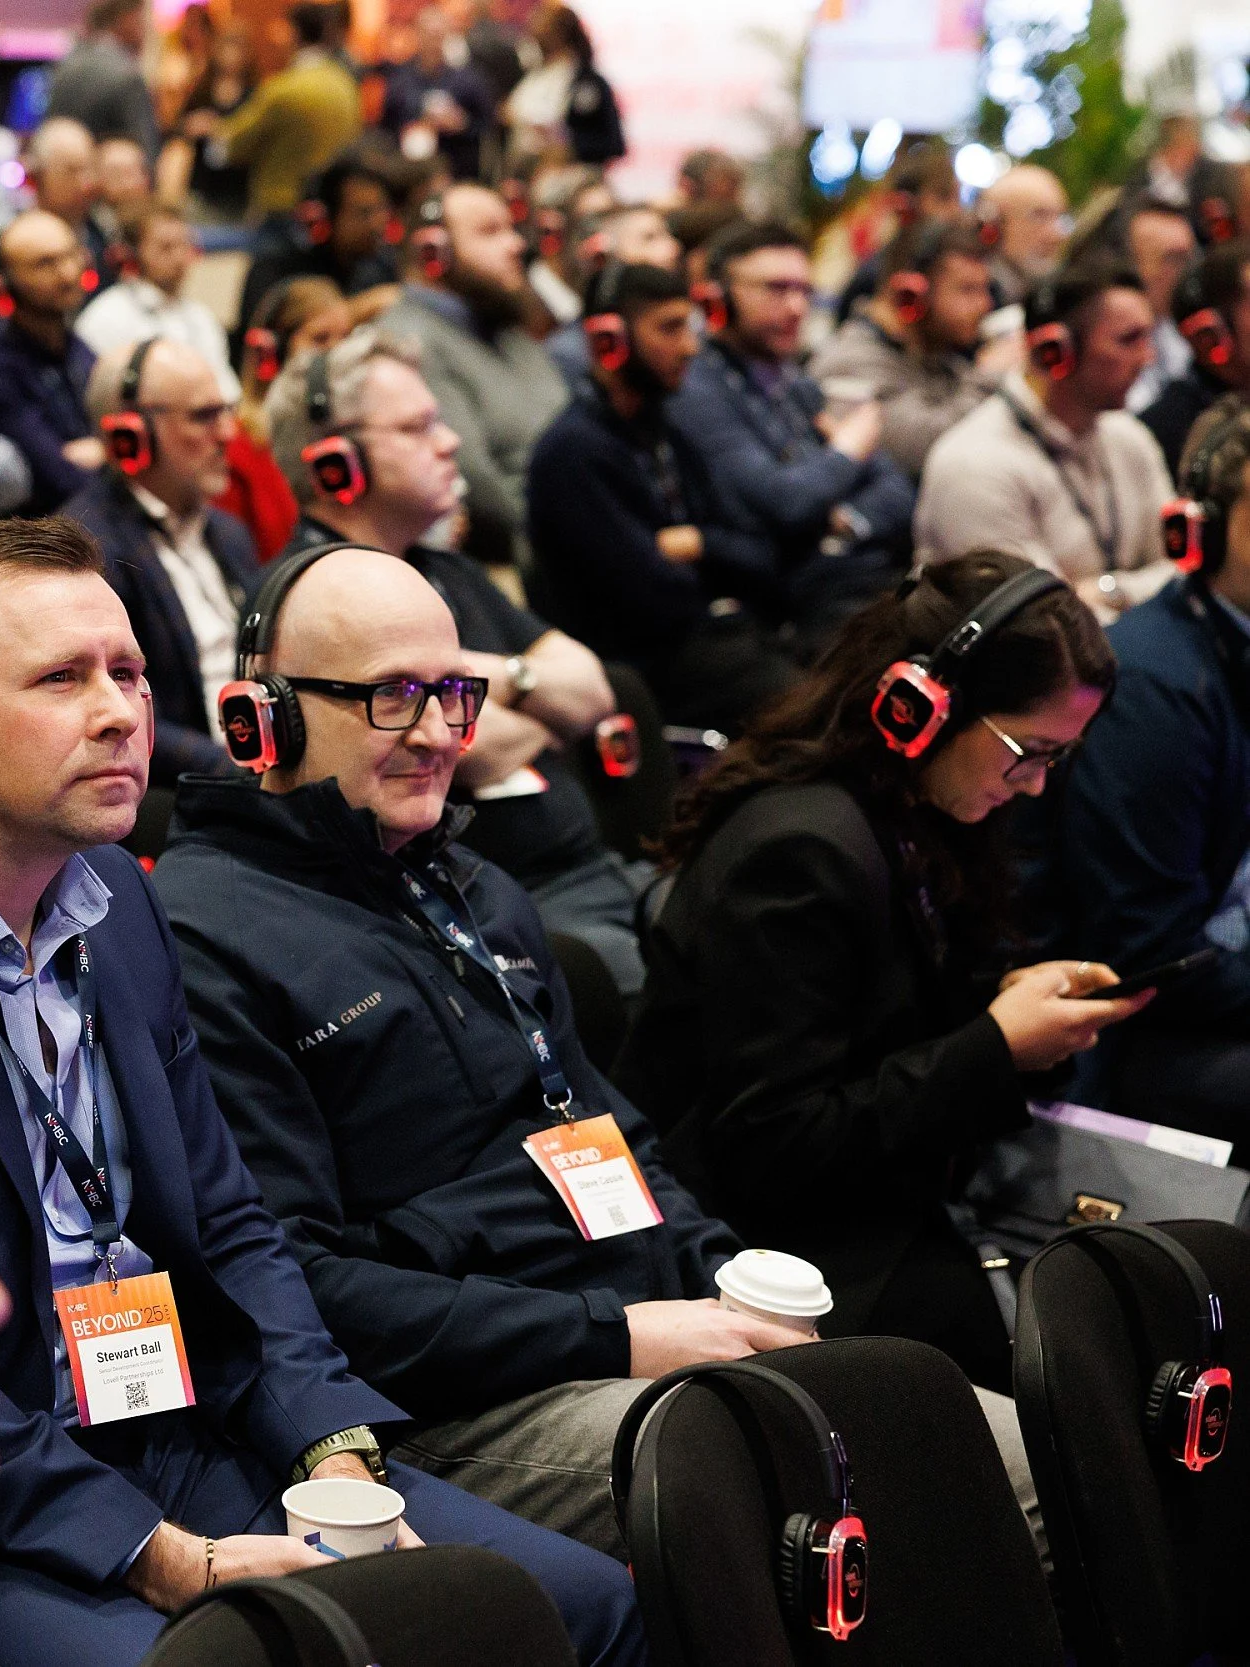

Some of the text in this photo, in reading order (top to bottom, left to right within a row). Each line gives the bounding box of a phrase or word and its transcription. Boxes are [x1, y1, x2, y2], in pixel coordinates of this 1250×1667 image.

[78, 939, 89, 973] NHBC
[340, 991, 382, 1024] GROUP
[531, 1030, 551, 1063] NHBC
[44, 1112, 69, 1146] NHBC
[81, 1178, 103, 1207] NHBC
[71, 1309, 142, 1338] BEYOND
[96, 1341, 162, 1363] Stewart Ball
[119, 1370, 154, 1382] Partnerships
[154, 1367, 164, 1375] Ltd
